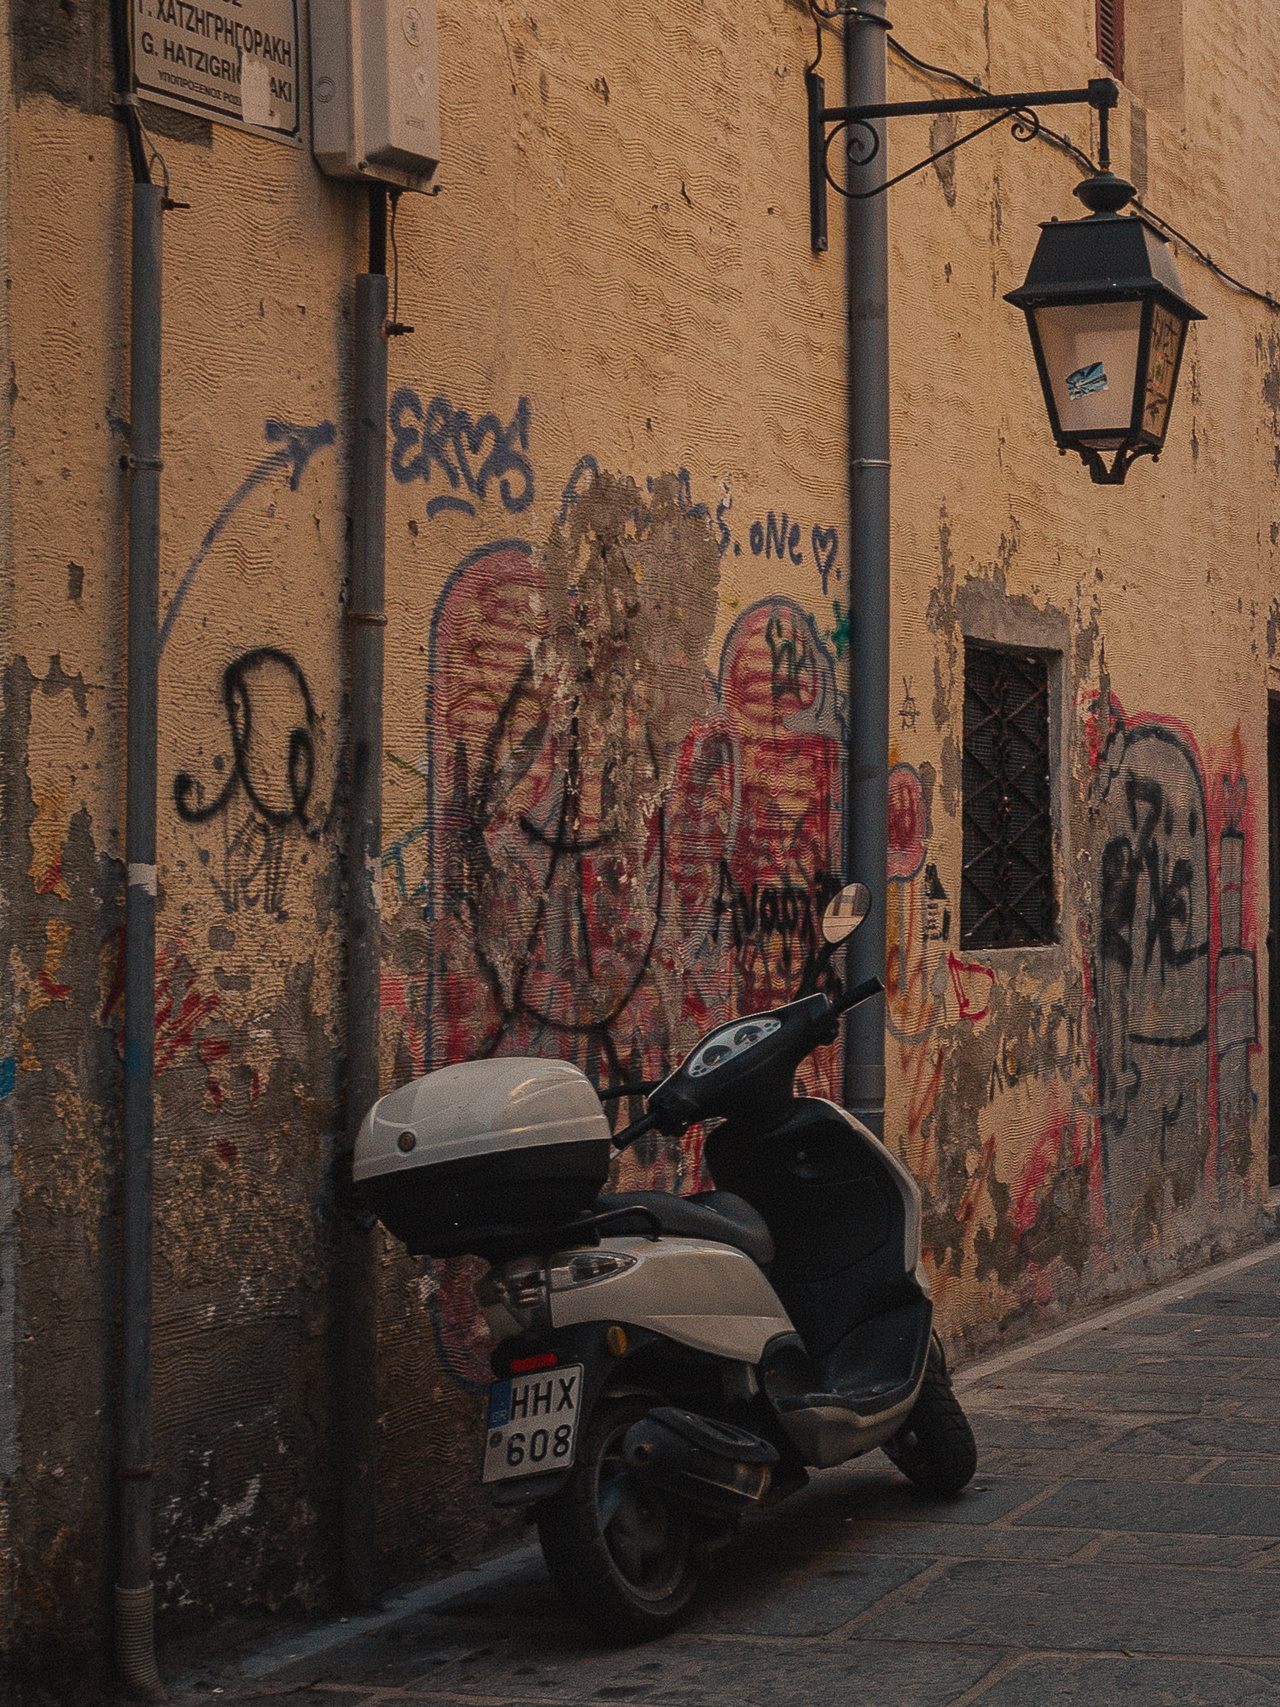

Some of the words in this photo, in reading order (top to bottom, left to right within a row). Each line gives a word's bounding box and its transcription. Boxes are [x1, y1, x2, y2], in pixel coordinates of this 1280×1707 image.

[141, 31, 159, 56] G.
[163, 38, 293, 103] HATZIGRIAKI
[510, 1376, 577, 1421] HHX
[506, 1423, 572, 1467] 608
